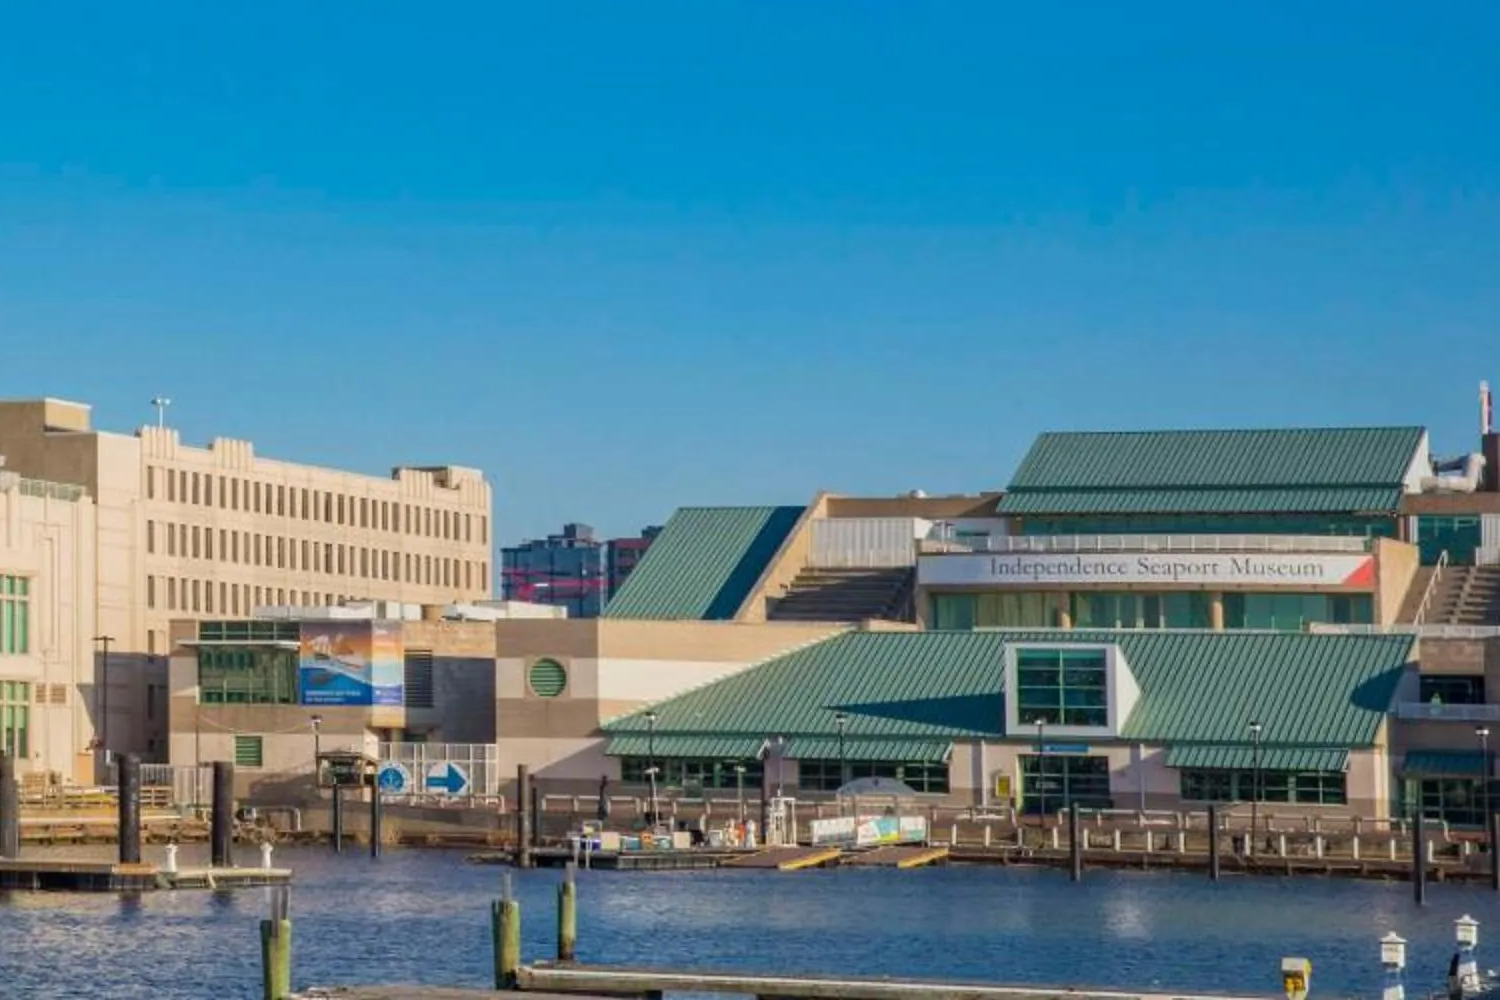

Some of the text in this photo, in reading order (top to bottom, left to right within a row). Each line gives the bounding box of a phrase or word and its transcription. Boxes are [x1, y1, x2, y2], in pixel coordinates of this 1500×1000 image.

[990, 556, 1324, 580] Independence Seaport Museum
